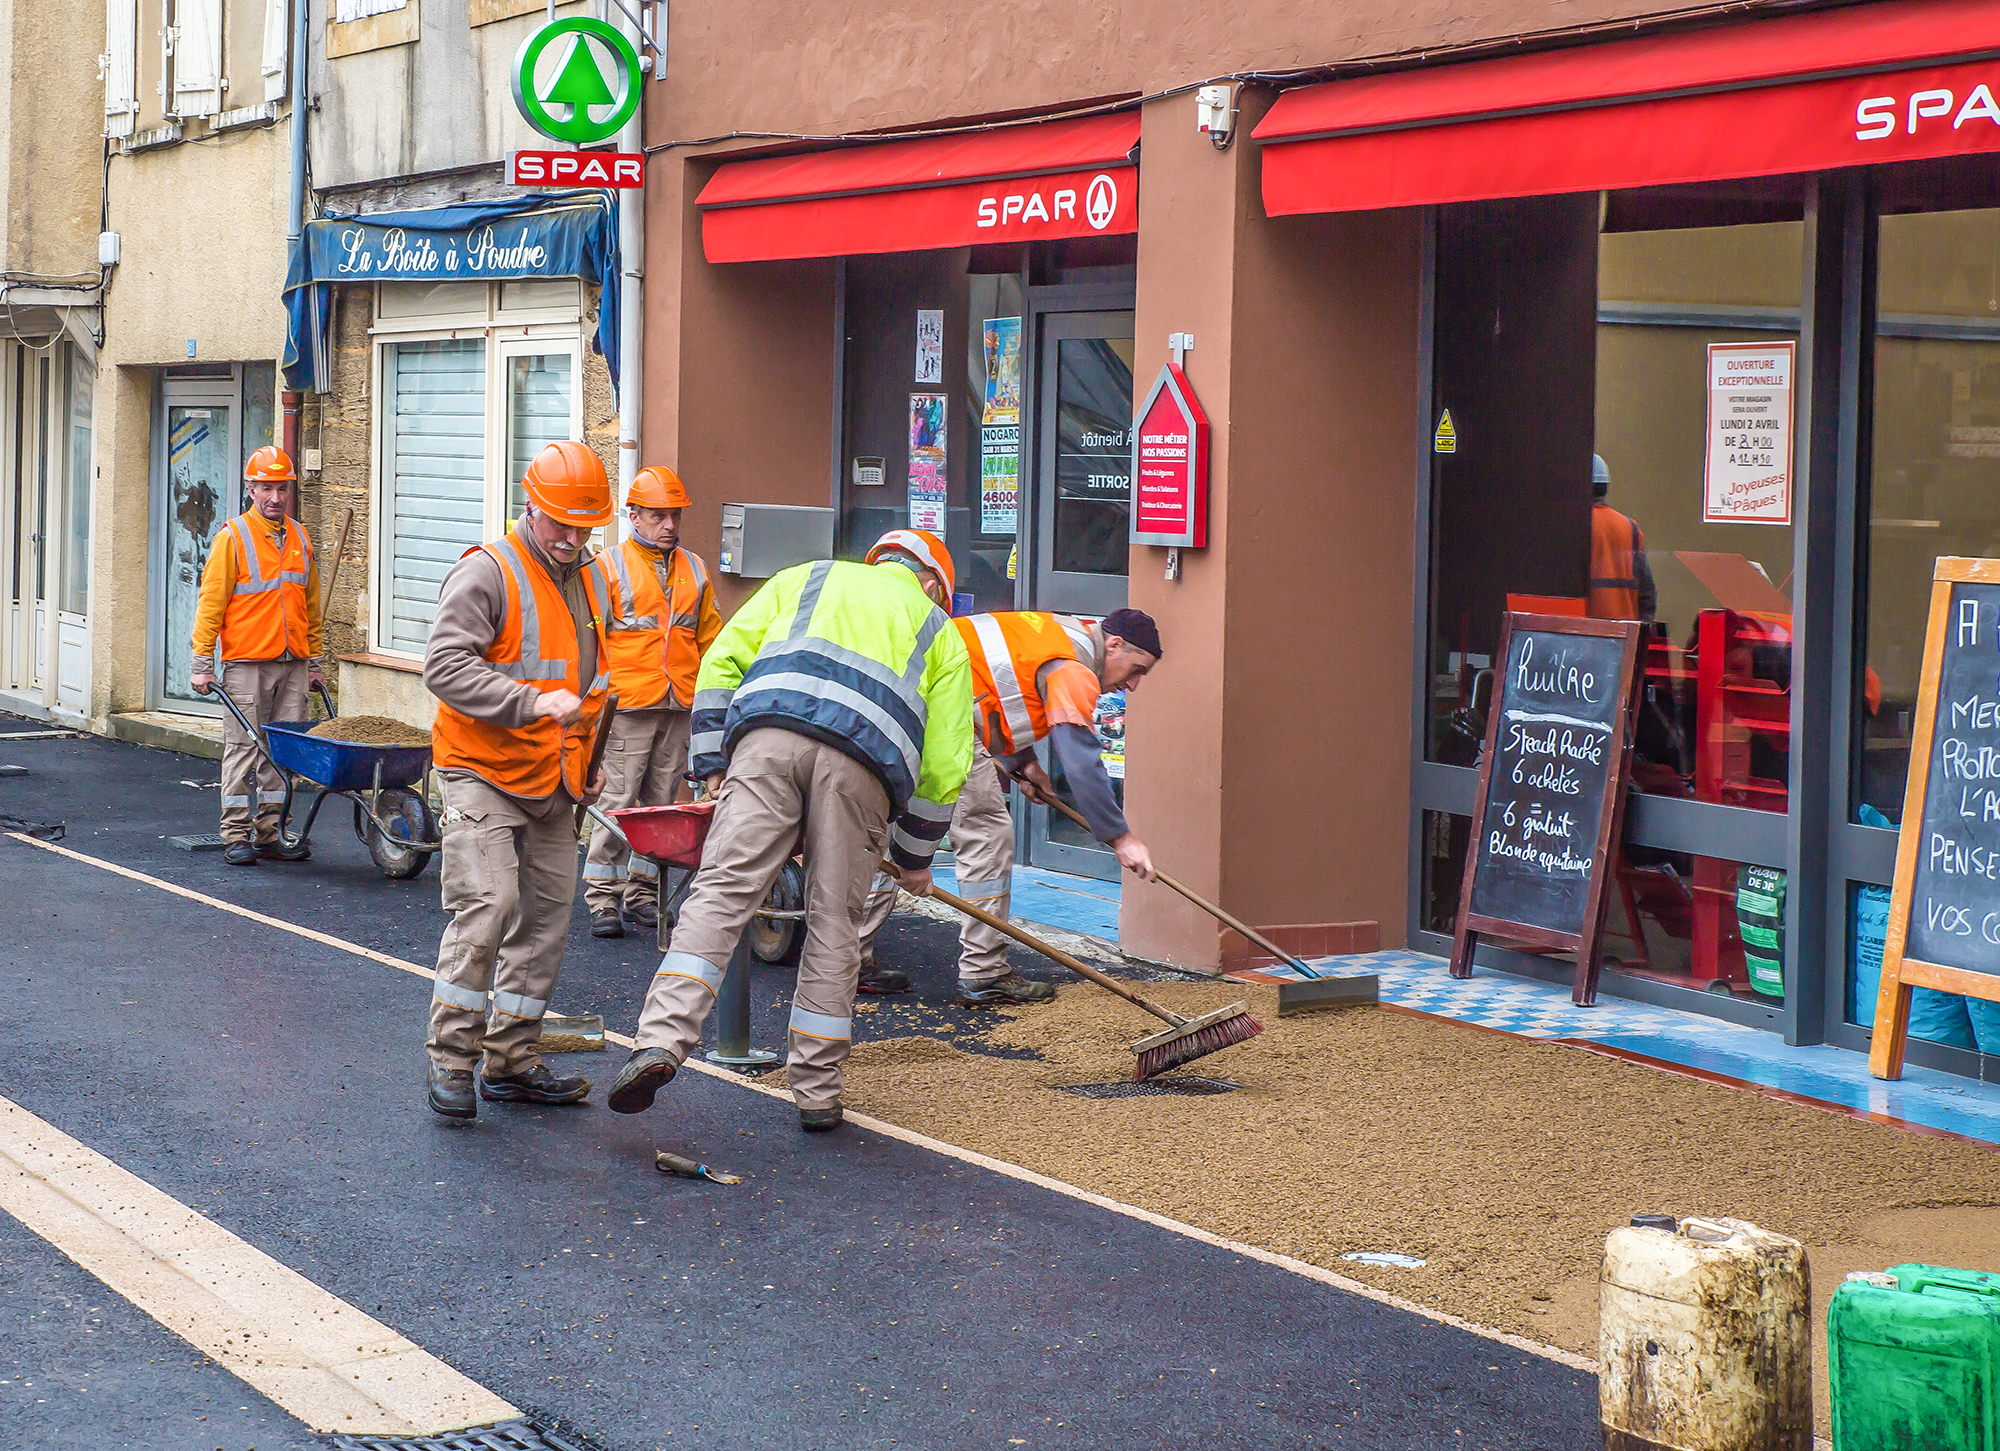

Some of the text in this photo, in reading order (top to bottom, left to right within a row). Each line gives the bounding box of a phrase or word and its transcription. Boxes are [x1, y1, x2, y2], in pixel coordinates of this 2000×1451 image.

[518, 156, 641, 182] SPAR
[976, 189, 1077, 228] SPAR
[338, 224, 548, 273] La Boîte à Poudre
[1726, 359, 1775, 371] OUVERTURE
[1717, 375, 1783, 387] EXCEPTIONNELLE
[983, 428, 1019, 441] NOGARO
[1720, 419, 1780, 430] LUNDI 2 AVRIL
[1142, 432, 1188, 444] NOTRE MÉTIER
[1725, 436, 1737, 447] DE
[1752, 436, 1760, 447] H
[1142, 447, 1187, 457] NOS PASSIONS
[1728, 453, 1737, 464] A
[1752, 453, 1759, 464] H
[1728, 473, 1786, 495] Joyeuses
[1733, 489, 1785, 513] Pâques !
[1559, 729, 1607, 766] haché
[1512, 758, 1580, 795] 6 achetés
[1502, 800, 1517, 827] 6
[1489, 830, 1538, 862] Blonde
[1748, 876, 1762, 889] DE
[1927, 896, 1972, 936] VOS
